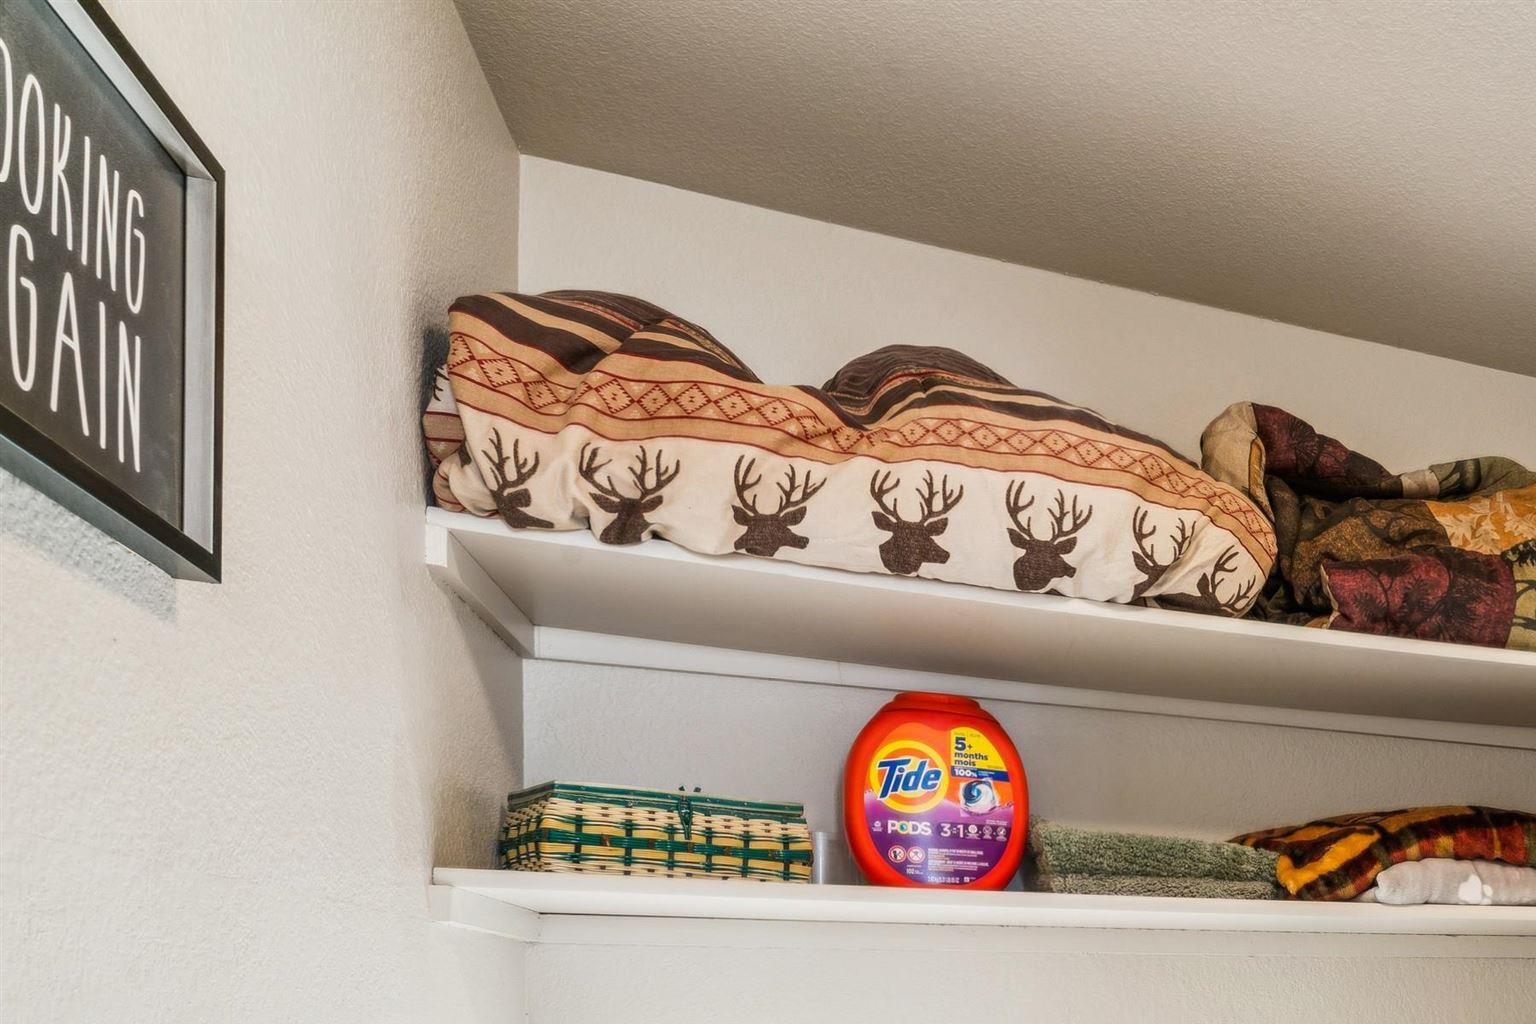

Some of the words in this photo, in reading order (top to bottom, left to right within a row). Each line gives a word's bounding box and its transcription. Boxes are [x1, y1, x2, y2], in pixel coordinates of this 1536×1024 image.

[9, 224, 141, 472] GAIN
[955, 752, 988, 760] months
[877, 757, 943, 800] Tide
[887, 819, 932, 837] PODS
